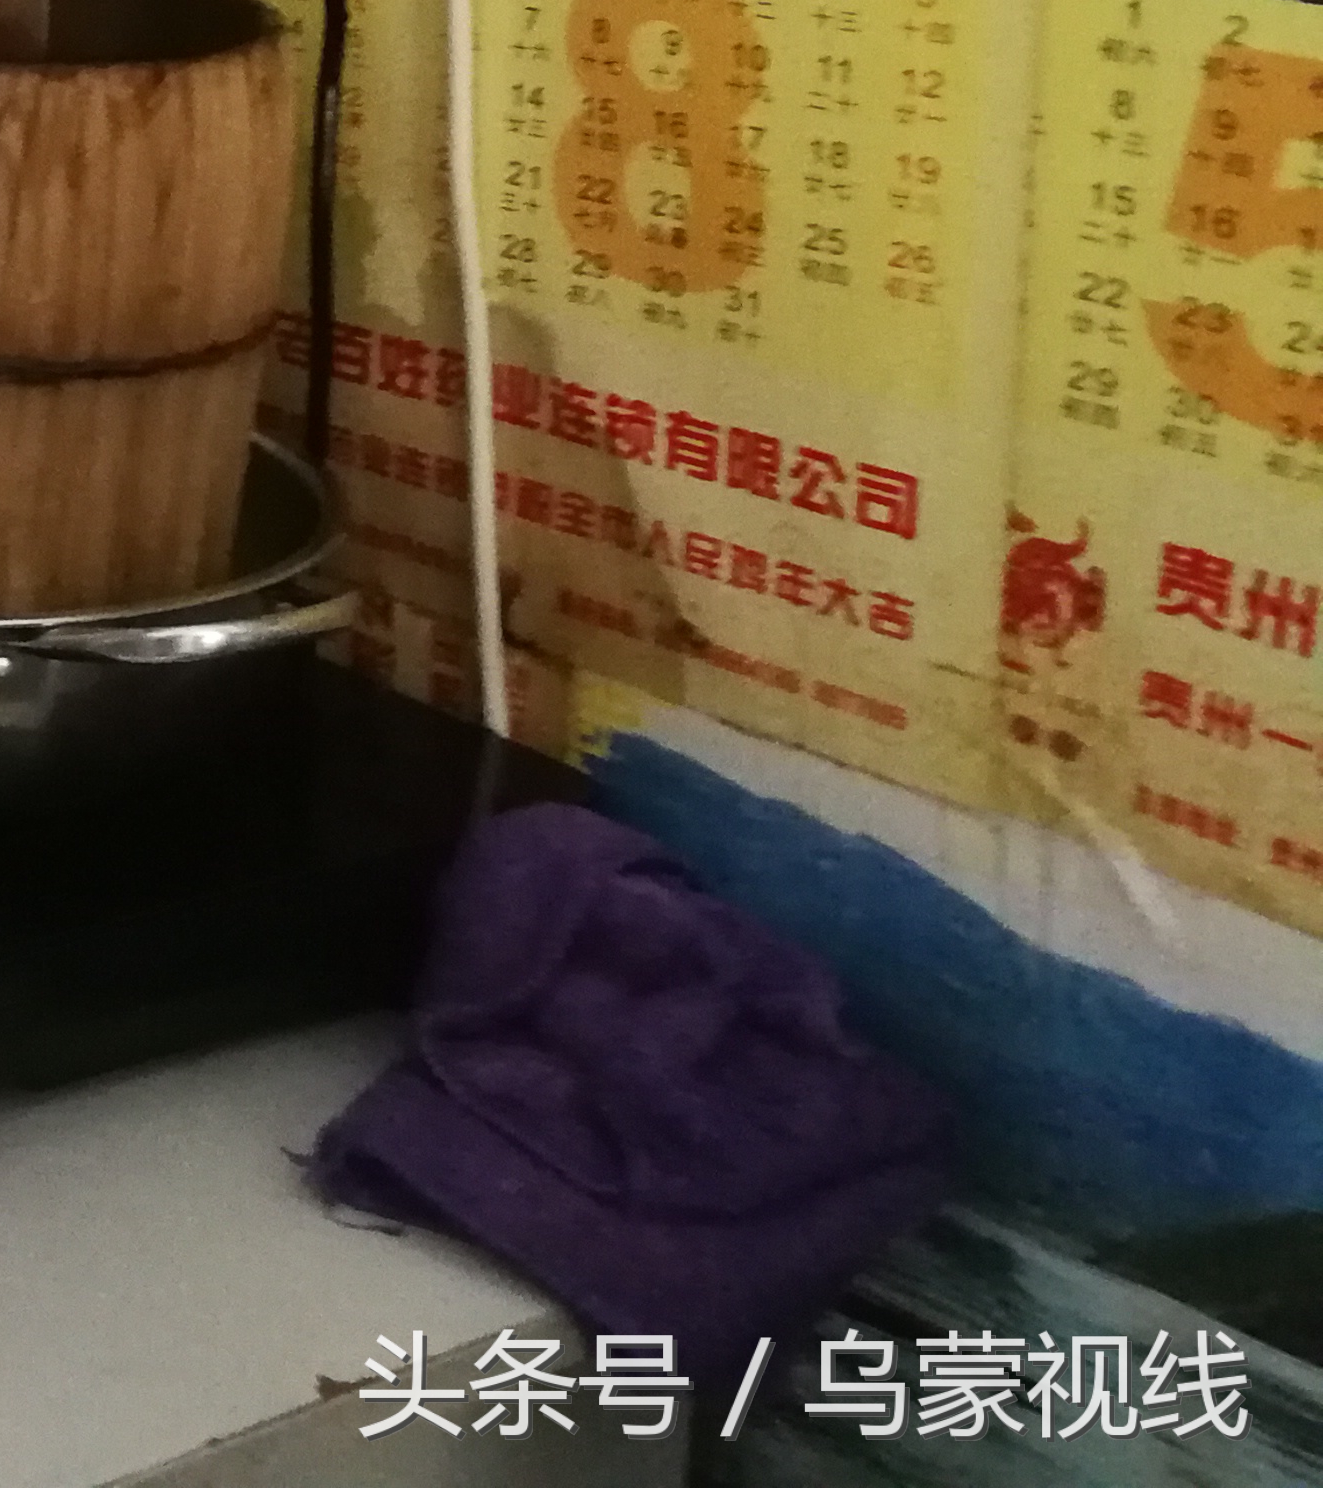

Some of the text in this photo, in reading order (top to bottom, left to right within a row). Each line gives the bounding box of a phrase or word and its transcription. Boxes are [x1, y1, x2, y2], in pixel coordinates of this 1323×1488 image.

[524, 6, 541, 31] 7
[661, 29, 684, 56] 9
[818, 55, 852, 84] 11
[902, 69, 944, 100] 12
[1222, 14, 1249, 46] 2
[511, 85, 546, 107] 14
[810, 140, 849, 169] 18
[896, 155, 942, 185] 19
[1110, 89, 1239, 142] 8 9
[504, 161, 542, 190] 21
[575, 174, 617, 205] 22
[649, 189, 689, 221] 23
[805, 223, 849, 256] 25
[887, 241, 937, 274] 26
[1092, 182, 1138, 216] 15
[1190, 204, 1242, 240] 16
[499, 233, 538, 263] 28
[723, 285, 763, 318] 31
[1073, 271, 1131, 309] 22
[1172, 296, 1233, 333] 23
[1067, 360, 1120, 397] 29
[1155, 541, 1320, 659] 贵州
